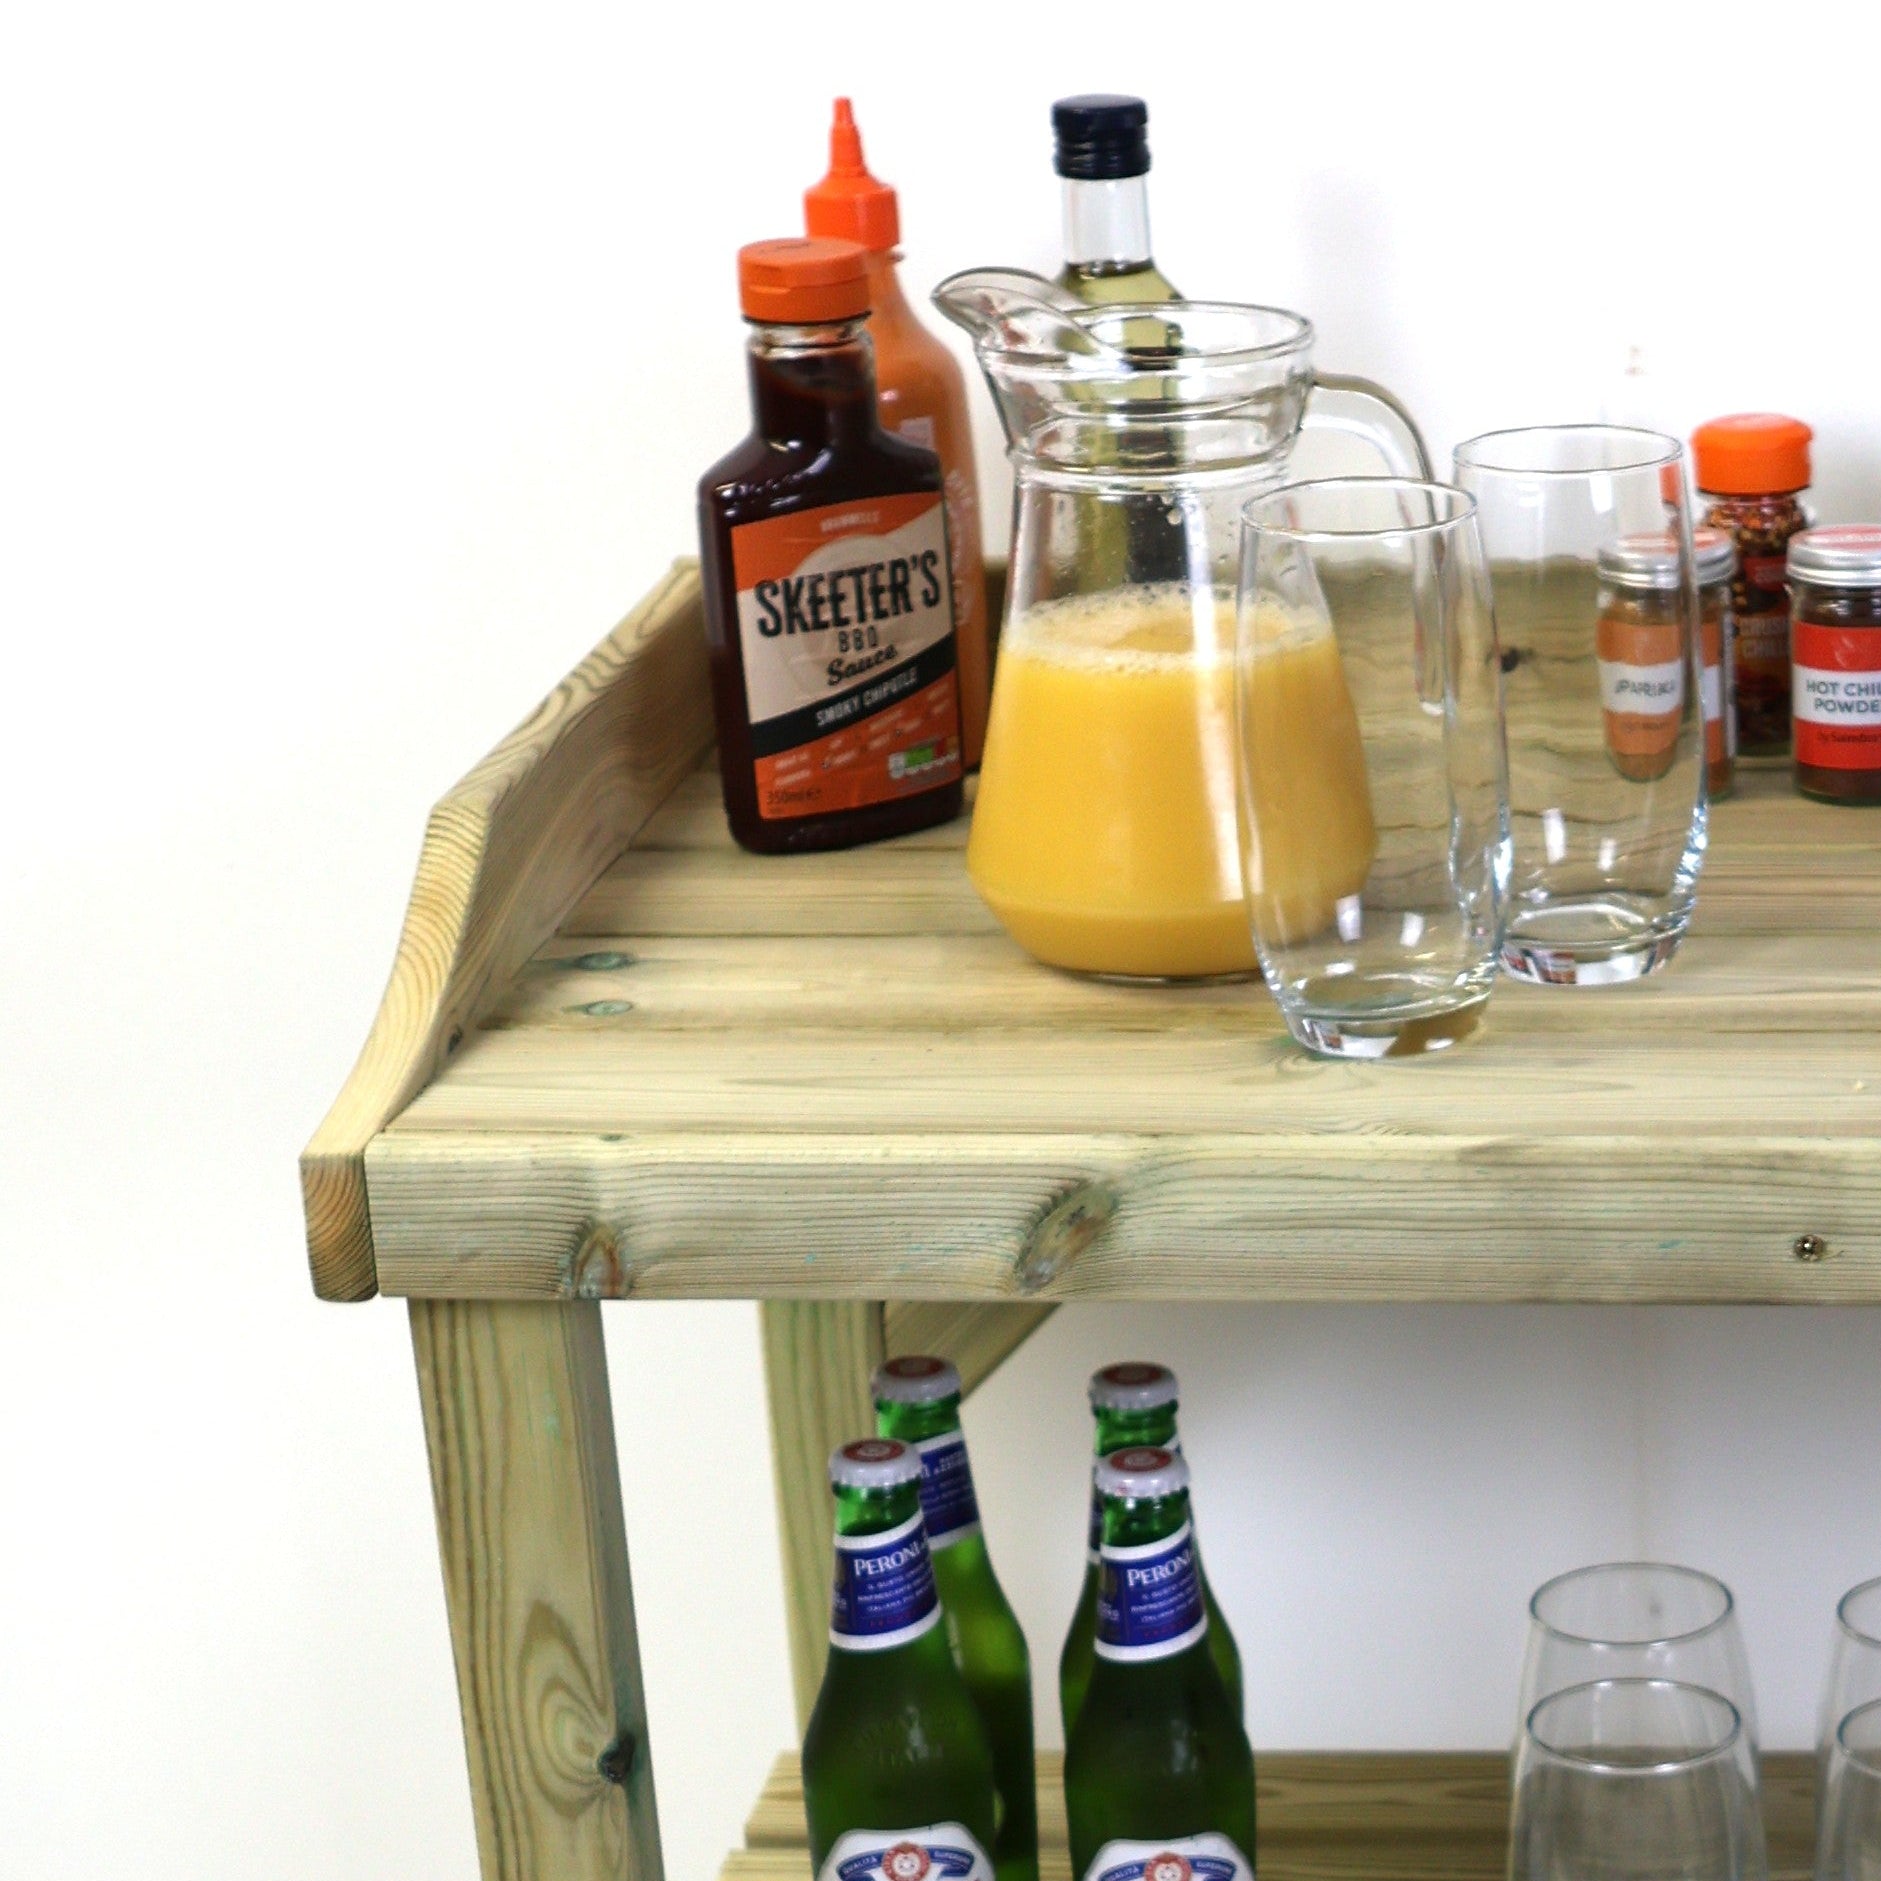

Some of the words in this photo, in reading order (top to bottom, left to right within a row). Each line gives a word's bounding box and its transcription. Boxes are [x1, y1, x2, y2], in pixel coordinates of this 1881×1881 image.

[754, 550, 940, 637] SKEETER'S
[838, 626, 879, 652] BBQ
[827, 645, 898, 686] Sauce
[1806, 680, 1838, 695] HOT
[853, 1541, 921, 1577] PERONI
